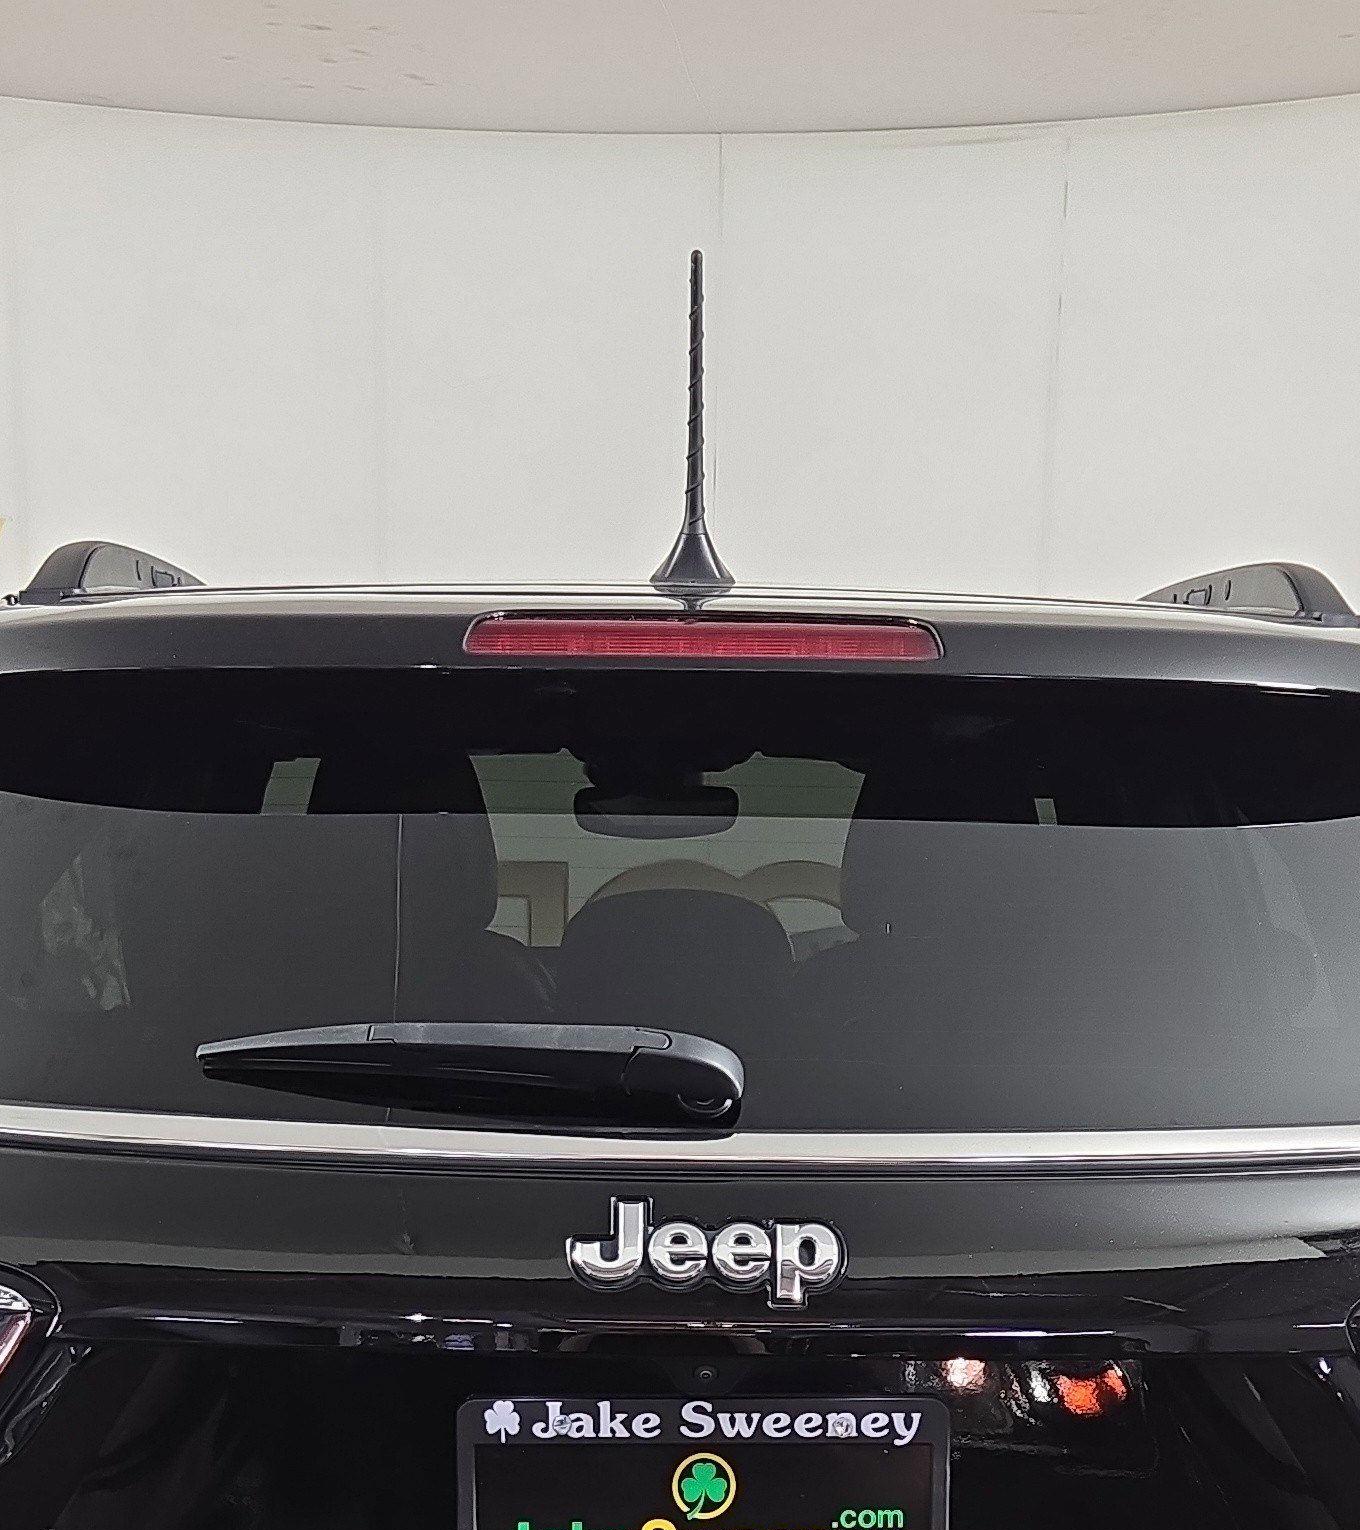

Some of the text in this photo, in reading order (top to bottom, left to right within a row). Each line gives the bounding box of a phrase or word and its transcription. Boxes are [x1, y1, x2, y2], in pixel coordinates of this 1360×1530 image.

[566, 1196, 848, 1310] Jeep
[532, 1400, 922, 1445] Jake Sweeney
